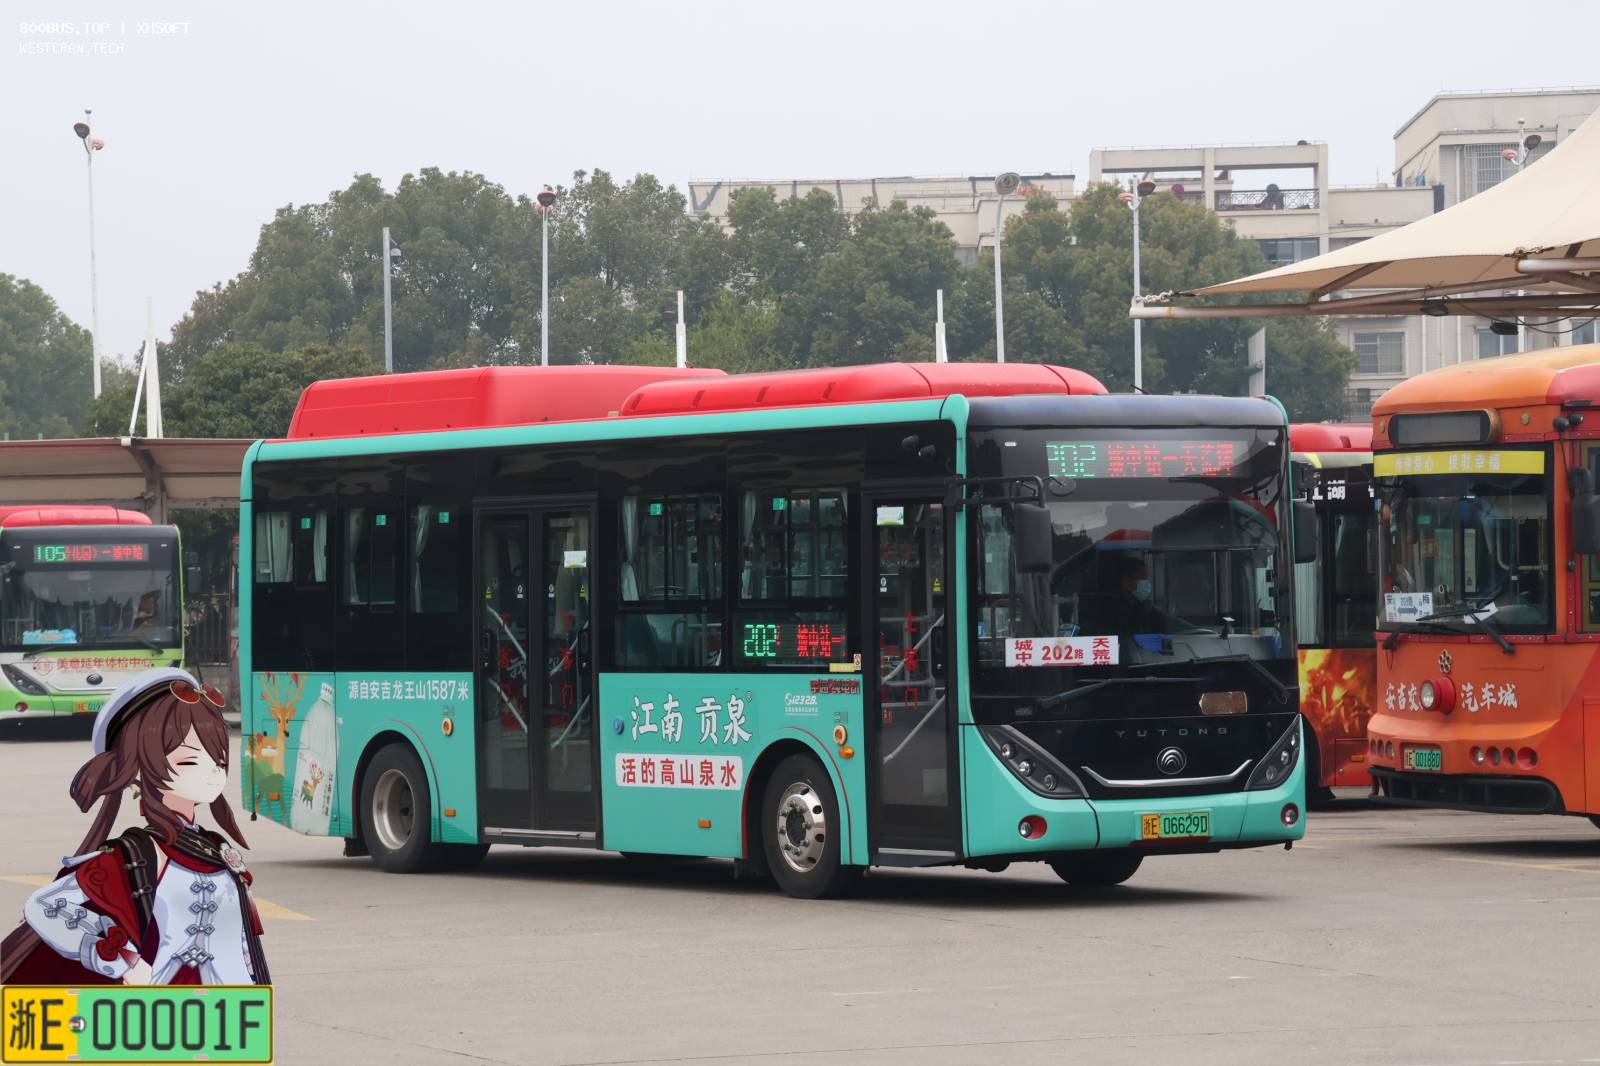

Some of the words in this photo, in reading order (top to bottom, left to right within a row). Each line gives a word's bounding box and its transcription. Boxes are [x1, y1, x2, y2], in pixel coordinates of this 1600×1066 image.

[1046, 445, 1096, 476] 202
[37, 546, 66, 561] 105
[744, 624, 777, 656] 202
[1042, 645, 1084, 661] 202路
[348, 680, 468, 699] 源自安吉龙王山1587米
[1461, 682, 1518, 712] 汽车城
[631, 693, 683, 742] 江南
[695, 694, 752, 745] 贡泉
[1115, 727, 1227, 738] YUTONG
[622, 758, 736, 787] 活的高山泉水
[1163, 815, 1208, 834] 06629D
